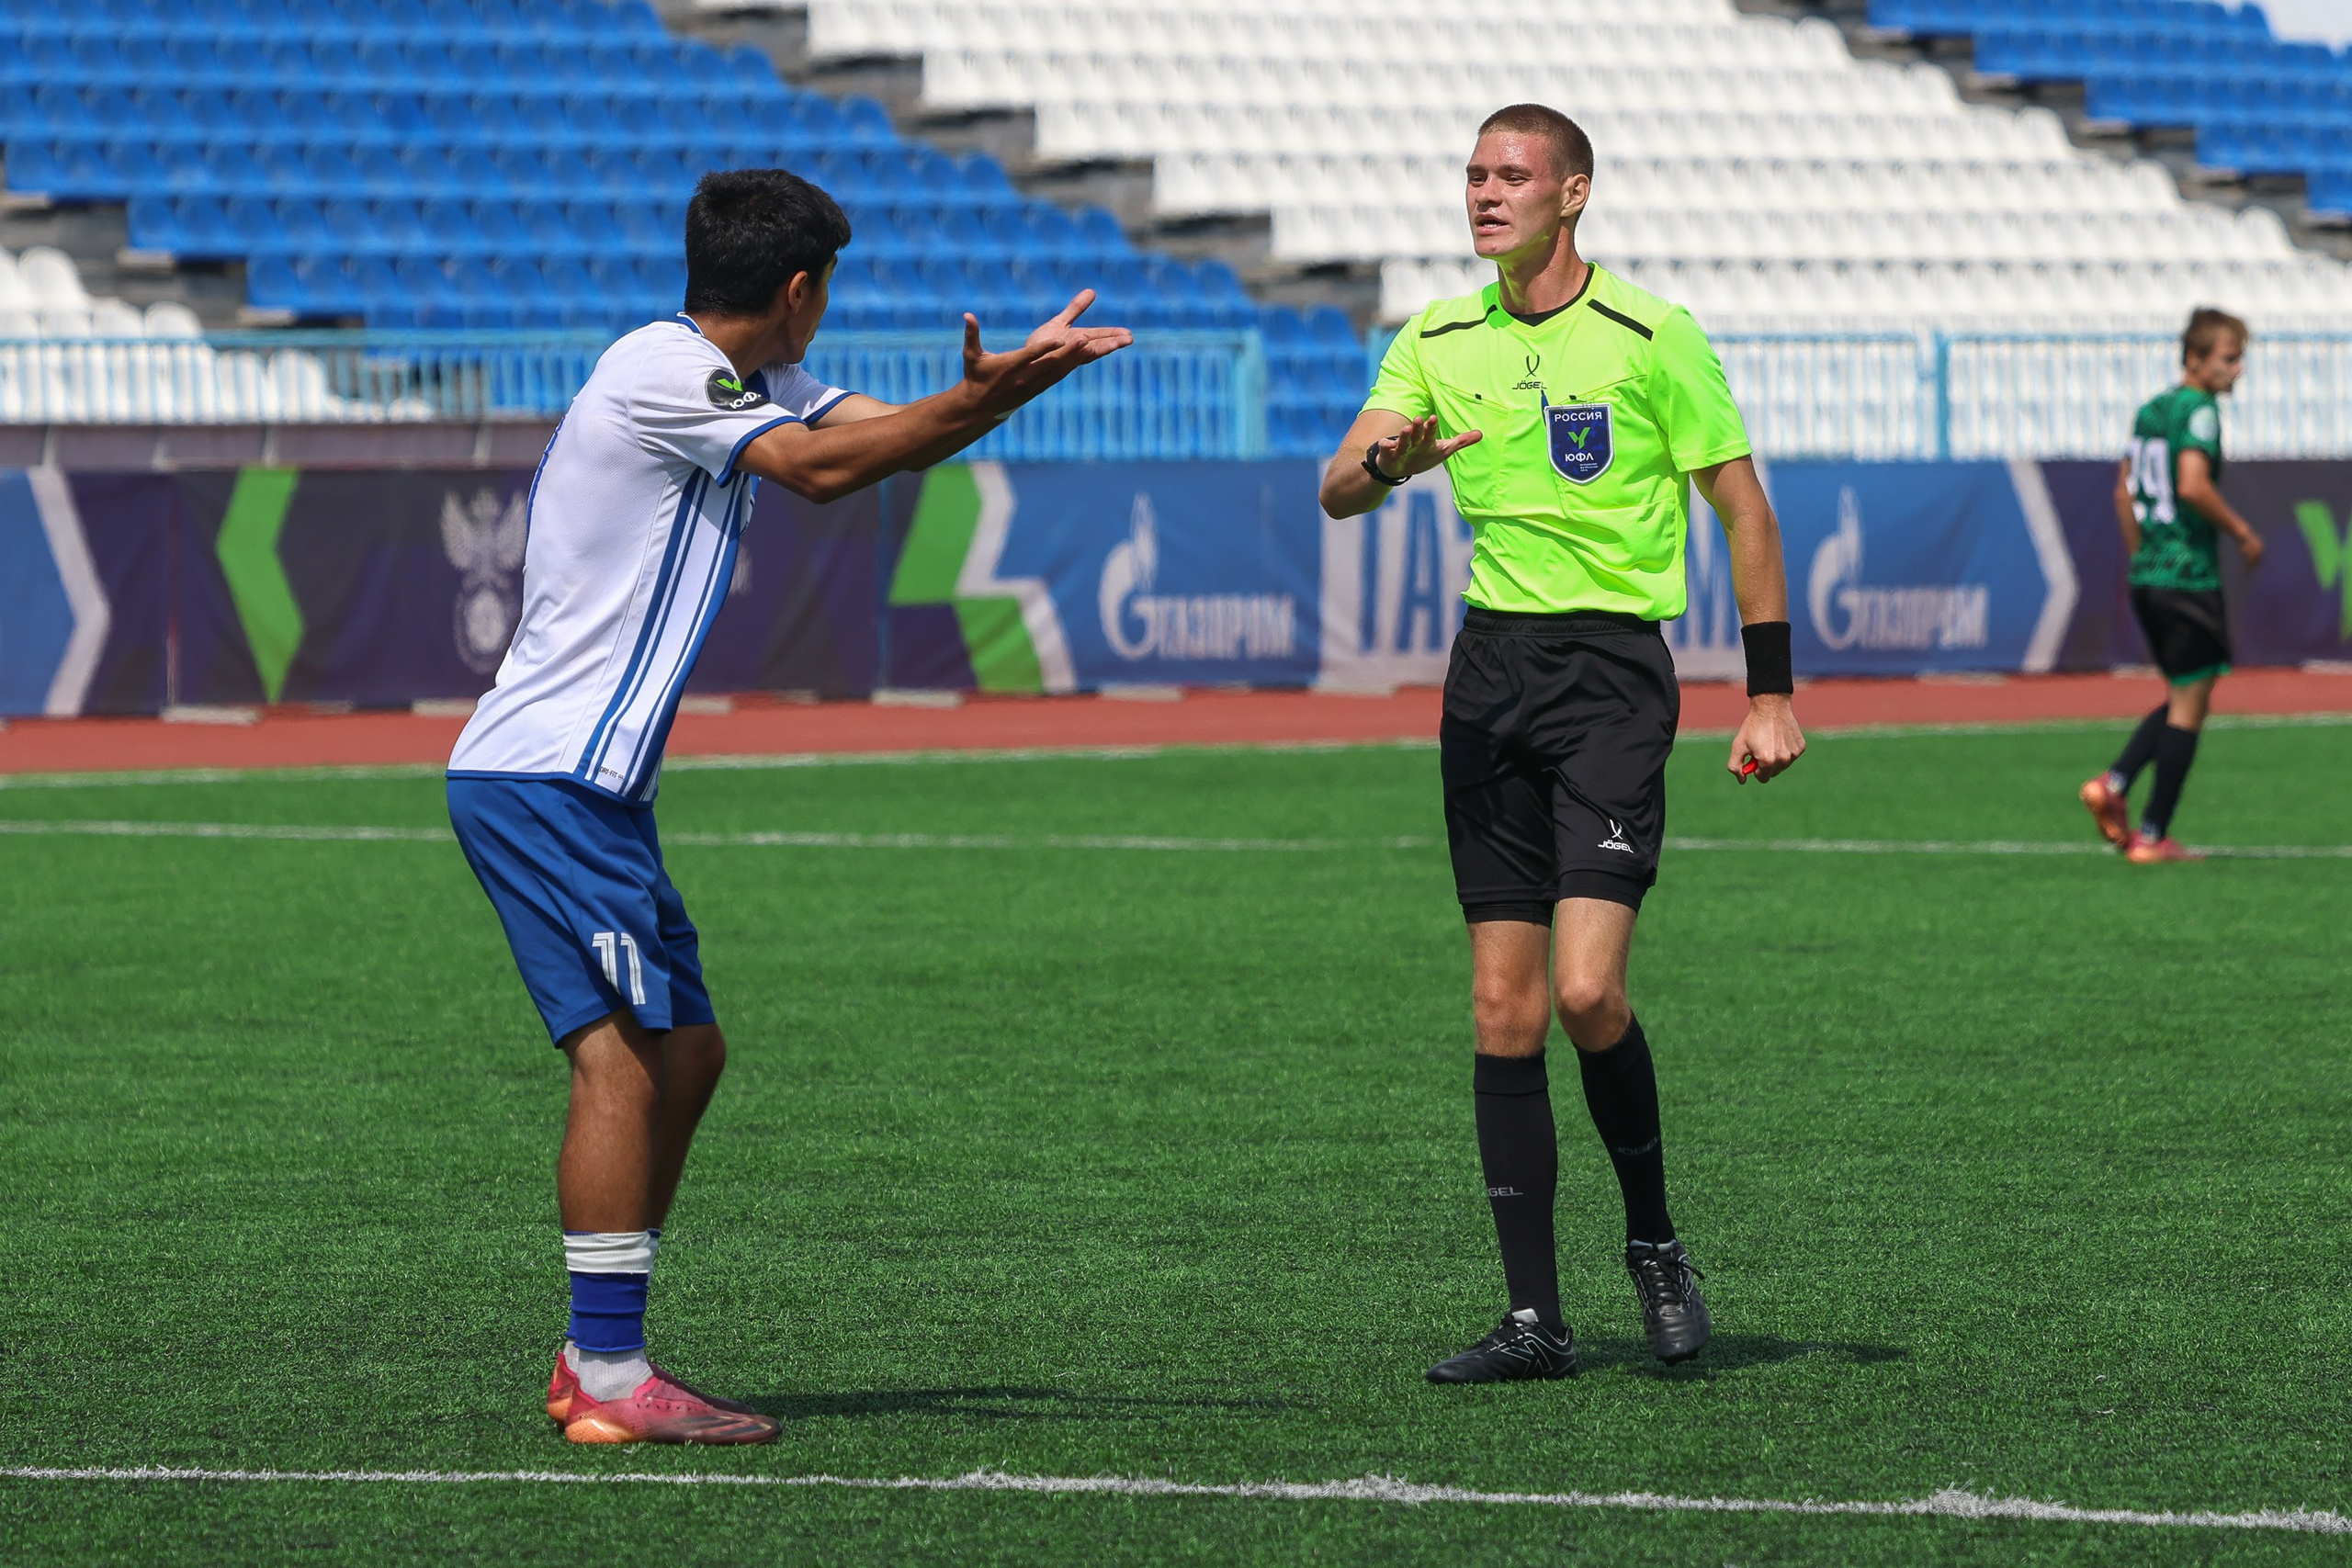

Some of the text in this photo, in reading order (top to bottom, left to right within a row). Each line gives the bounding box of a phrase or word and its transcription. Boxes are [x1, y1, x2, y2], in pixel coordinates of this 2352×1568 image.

[1512, 379, 1547, 389] JÖGEL
[729, 392, 762, 410] ЮФ
[1555, 412, 1602, 423] РОССИЯ
[1565, 452, 1594, 462] ЮФЛ
[1598, 840, 1634, 853] JÖGEL
[592, 931, 646, 1005] 11
[1488, 1186, 1523, 1197] GEL
